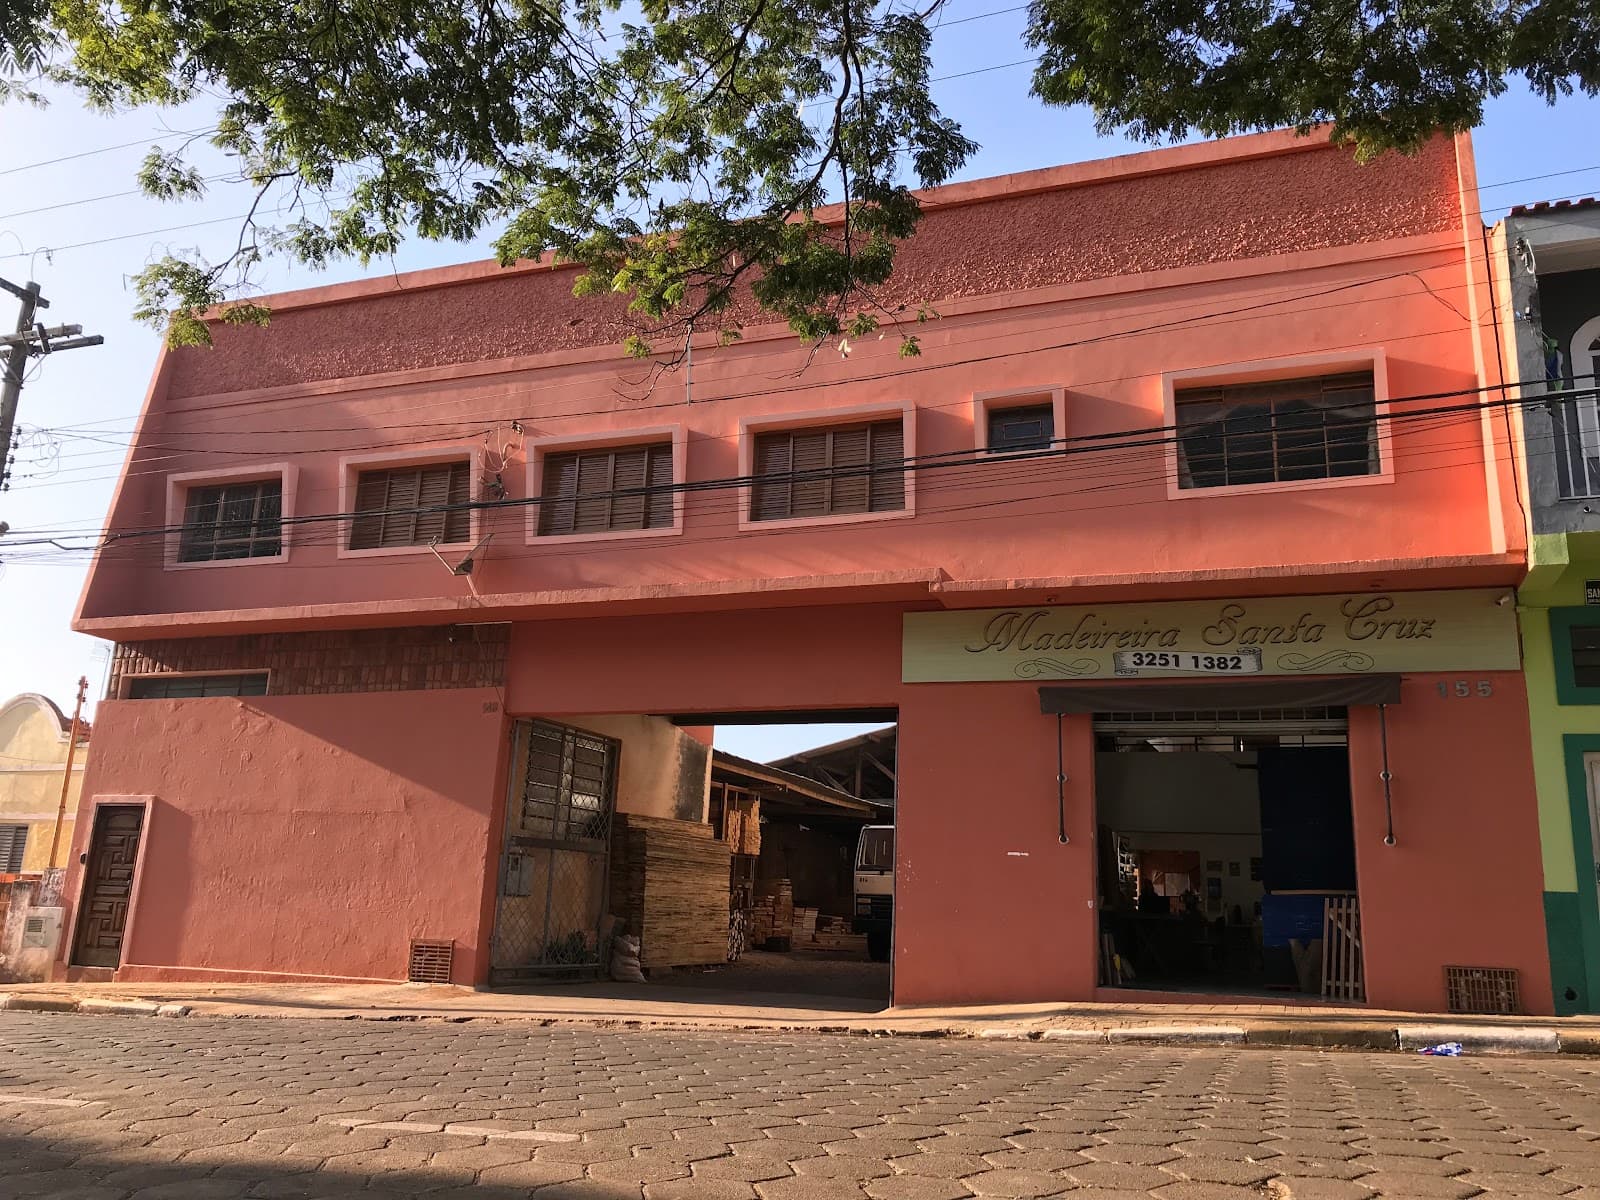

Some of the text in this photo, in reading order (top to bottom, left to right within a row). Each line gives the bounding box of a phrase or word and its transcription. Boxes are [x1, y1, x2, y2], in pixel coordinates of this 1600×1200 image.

[965, 597, 1437, 653] Madeireira Santa Cruz
[1132, 652, 1242, 670] 3251 1382
[1436, 680, 1493, 697] 155
